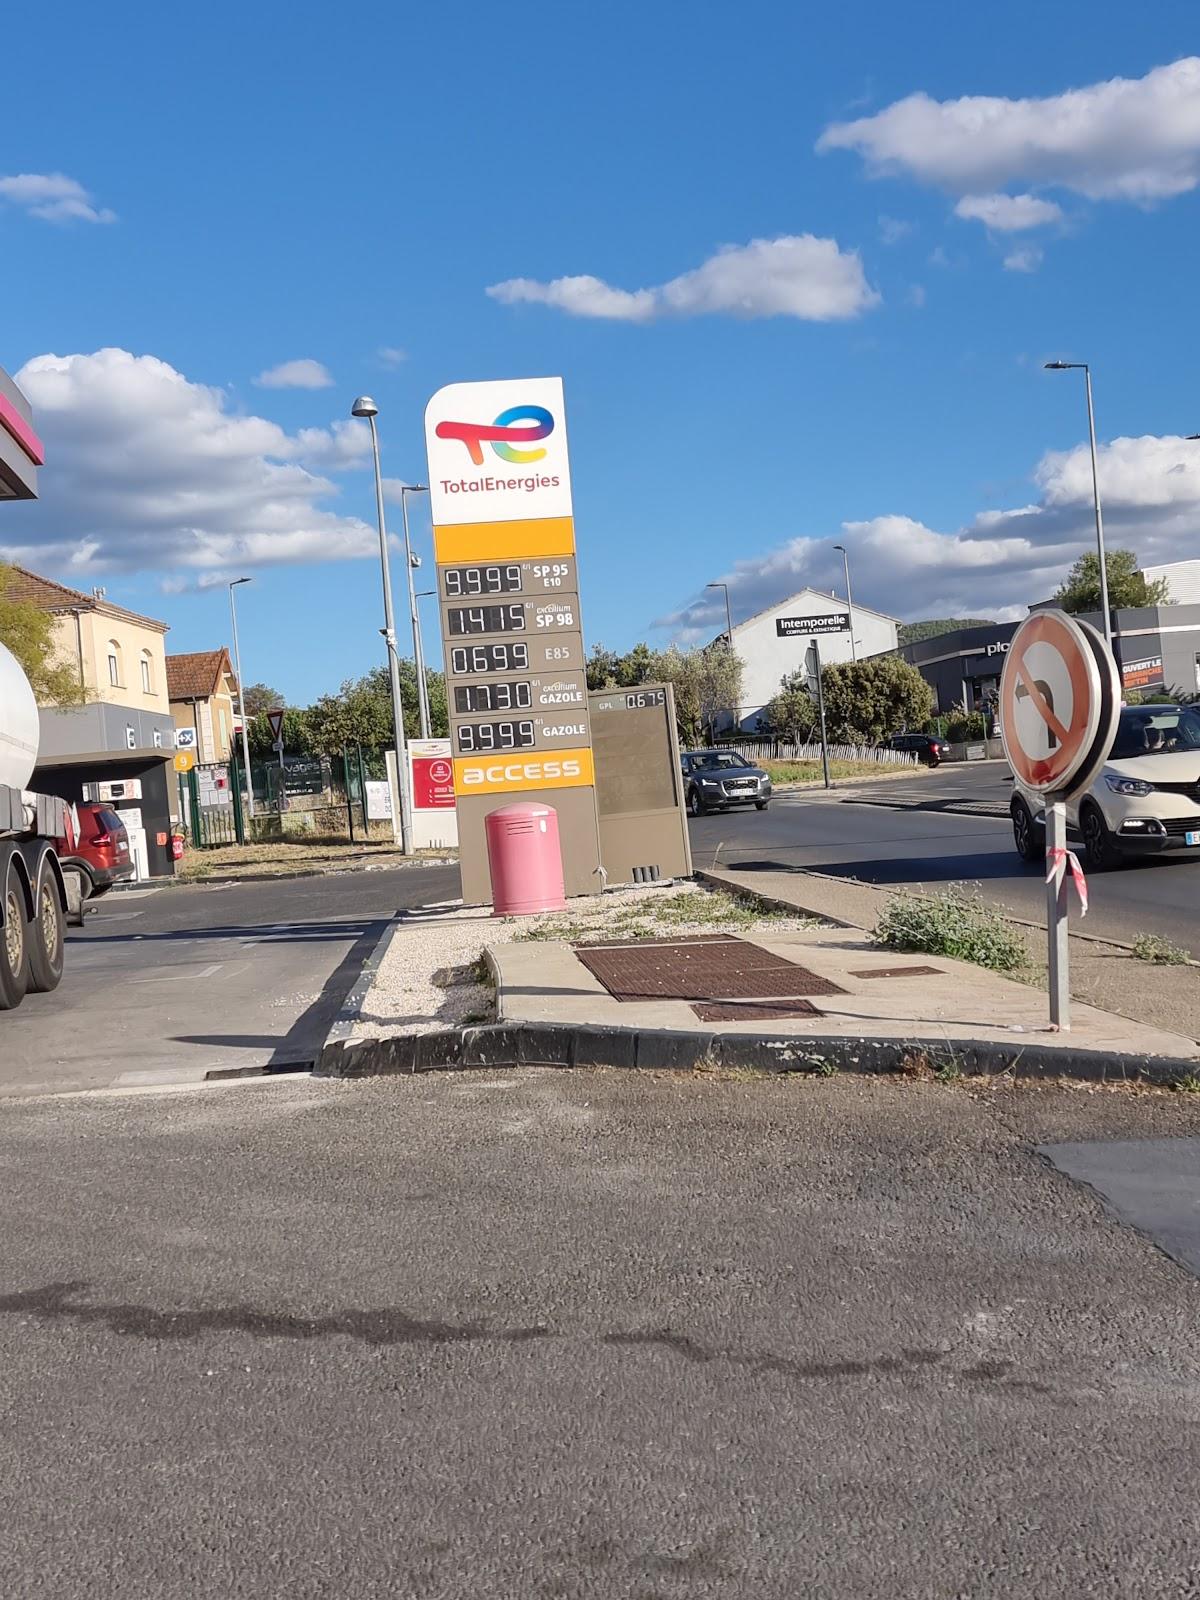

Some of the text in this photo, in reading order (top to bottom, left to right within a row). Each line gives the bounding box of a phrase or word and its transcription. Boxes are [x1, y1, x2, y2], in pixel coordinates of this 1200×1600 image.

[440, 473, 560, 494] TotalEnergies
[533, 564, 569, 578] SP 95
[445, 566, 522, 596] 9.999
[543, 577, 562, 587] E10
[459, 604, 526, 634] 1.415
[536, 613, 574, 628] SP 98
[781, 615, 846, 628] Intemporelle
[452, 643, 570, 674] 0.699 E85
[1122, 658, 1162, 674] OUVERT LE
[466, 682, 532, 711] 1.730
[539, 691, 583, 704] GAZOLE
[599, 702, 613, 710] GPL
[458, 721, 536, 751] 9.999
[542, 724, 586, 737] GAZOLE
